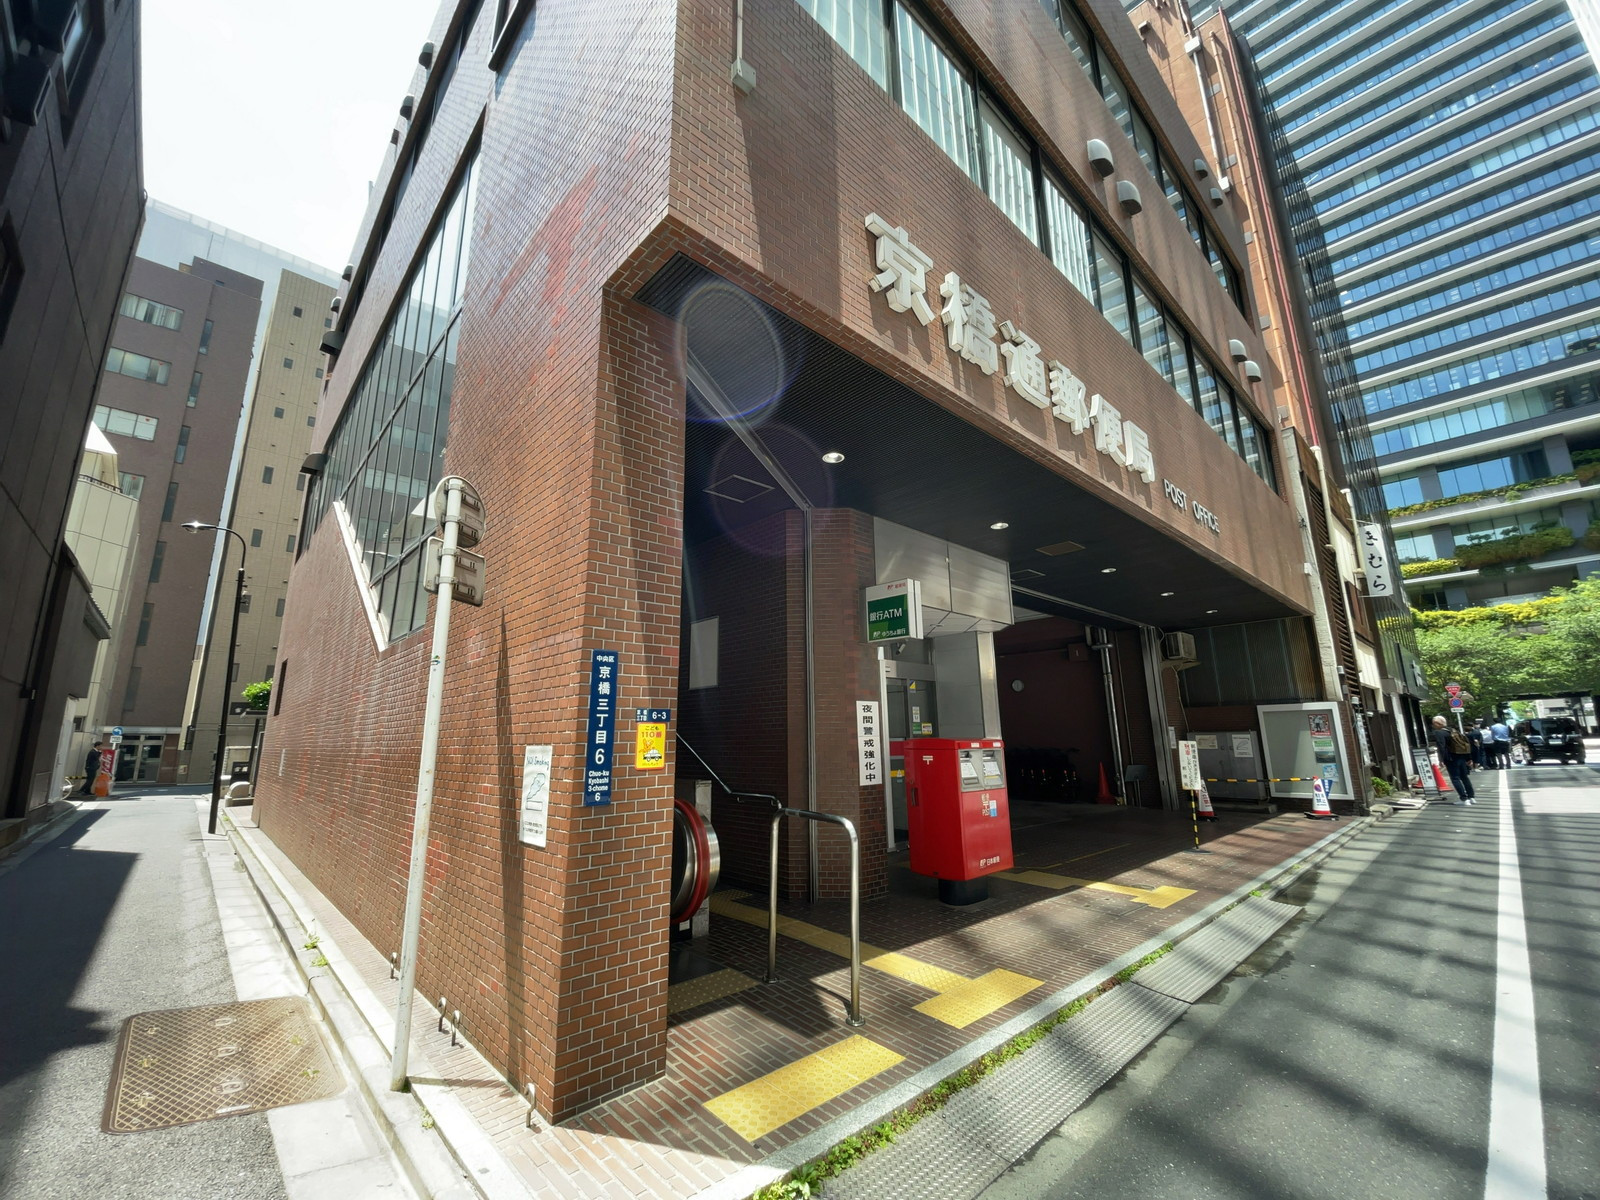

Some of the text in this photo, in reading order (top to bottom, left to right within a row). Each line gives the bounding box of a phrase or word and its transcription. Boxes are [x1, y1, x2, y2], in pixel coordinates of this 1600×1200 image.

[864, 212, 1155, 483] 京橋通郵便局
[1163, 478, 1220, 533] POST OFFICE
[1365, 531, 1387, 592] きむら
[869, 607, 903, 622] 銀行ATM
[881, 628, 906, 637] ゆうちょ銀行
[596, 655, 615, 663] 中央区
[652, 711, 667, 720] 6-3
[862, 704, 876, 782] 夜間警戒強化中
[588, 777, 609, 786] Kyobashi
[594, 792, 601, 802] 6
